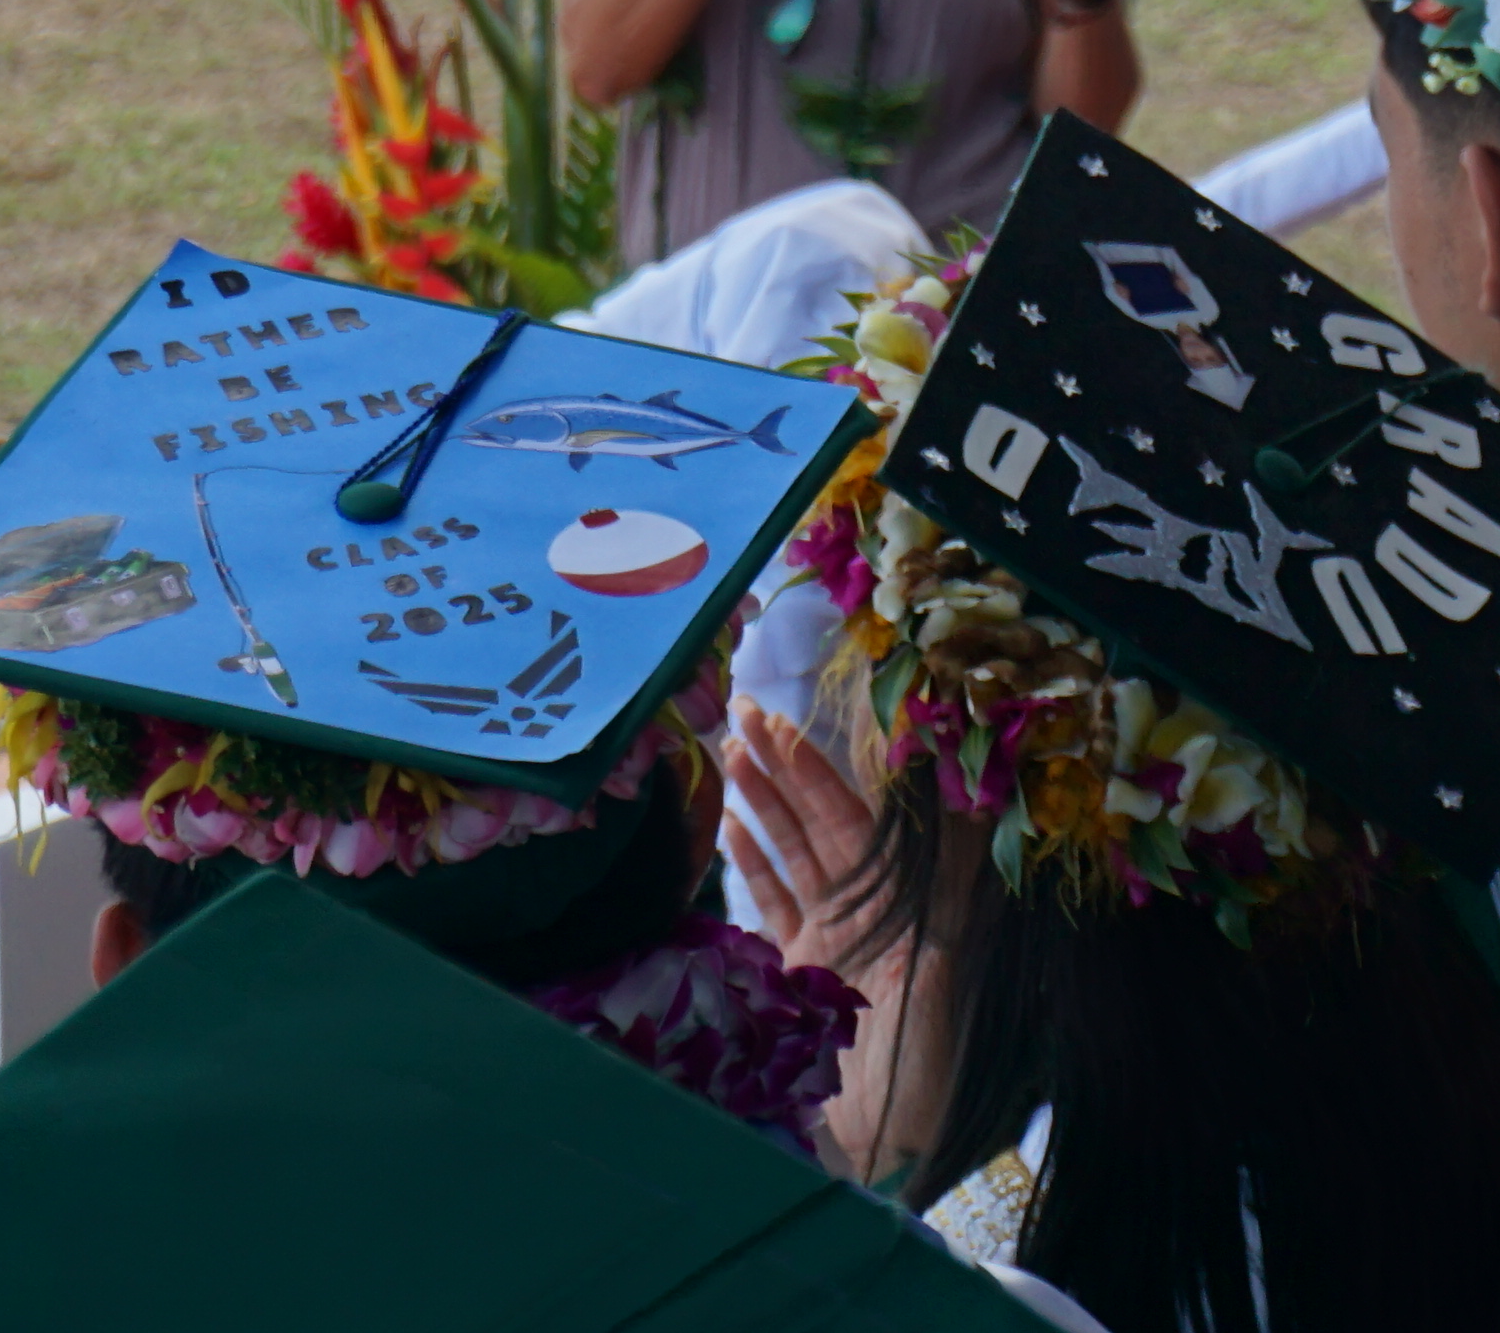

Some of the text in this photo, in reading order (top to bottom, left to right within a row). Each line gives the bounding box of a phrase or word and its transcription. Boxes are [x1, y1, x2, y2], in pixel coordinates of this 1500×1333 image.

[108, 307, 370, 376] RATHER
[218, 365, 301, 402] BE
[152, 381, 448, 462] FISHING
[306, 517, 480, 571] CLASS
[384, 565, 448, 597] OF
[359, 583, 534, 643] 2025
